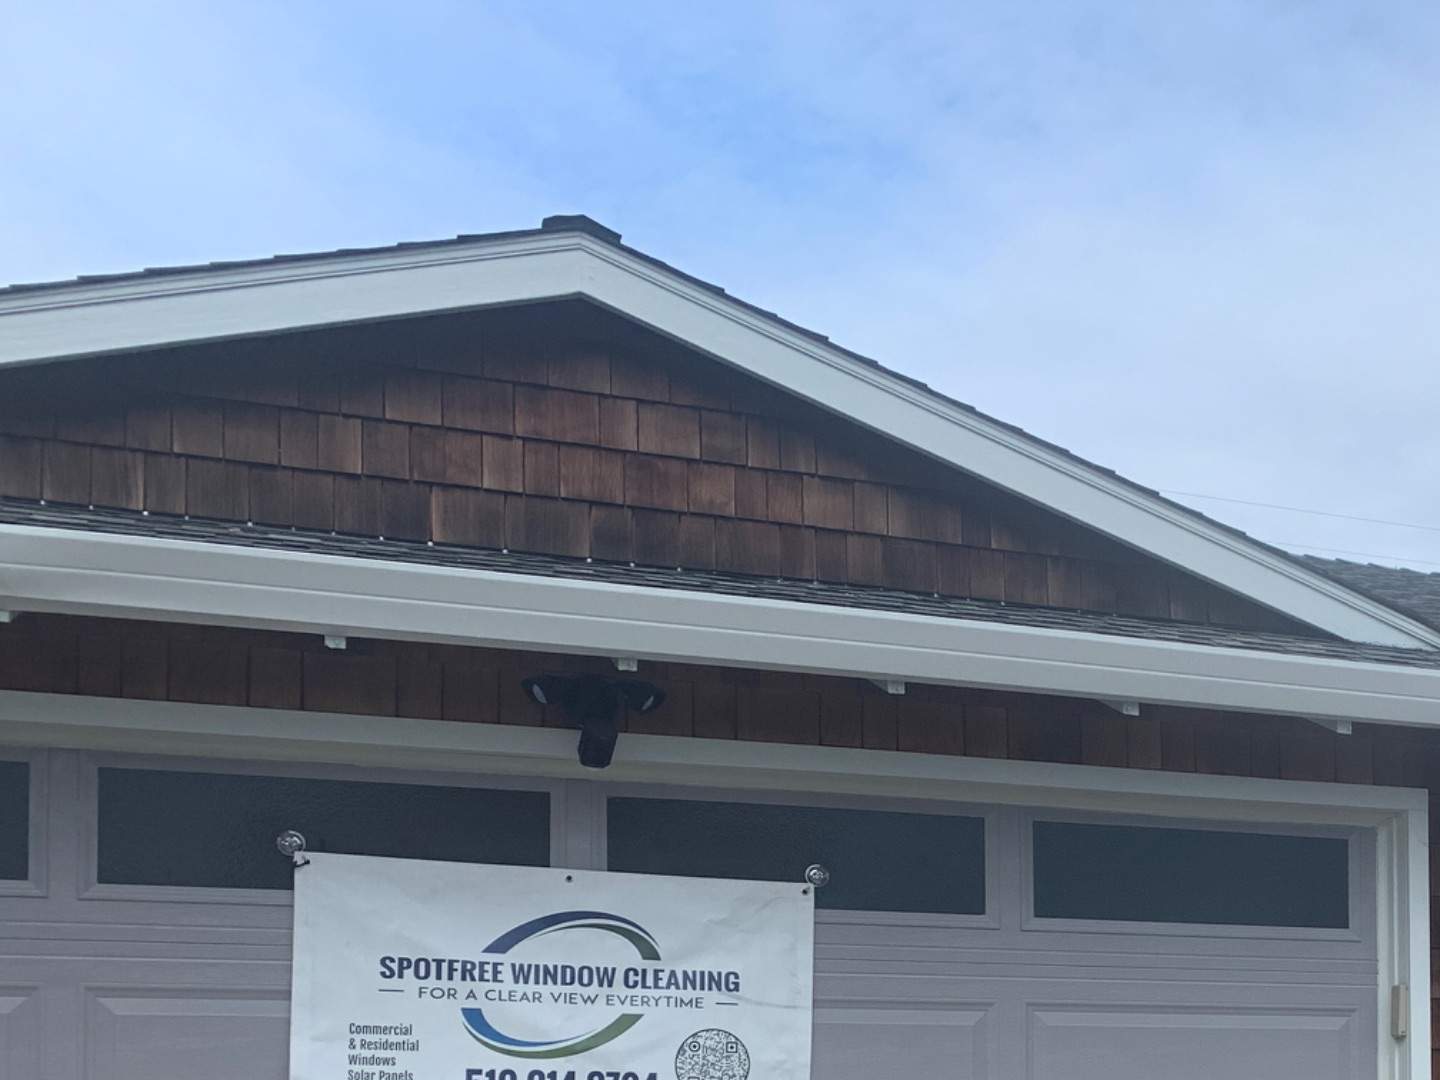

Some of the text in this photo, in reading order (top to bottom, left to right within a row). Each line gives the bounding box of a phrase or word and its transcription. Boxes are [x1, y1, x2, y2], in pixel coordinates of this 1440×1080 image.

[379, 956, 740, 992] SPOTFREE WINDOW CLEANING
[418, 986, 705, 1009] FOR A CLEAR VIEW EVERYTIME
[349, 1022, 413, 1036] Commercial
[348, 1038, 420, 1052] & Residential
[348, 1054, 397, 1066] Windows
[347, 1069, 376, 1080] Solar
